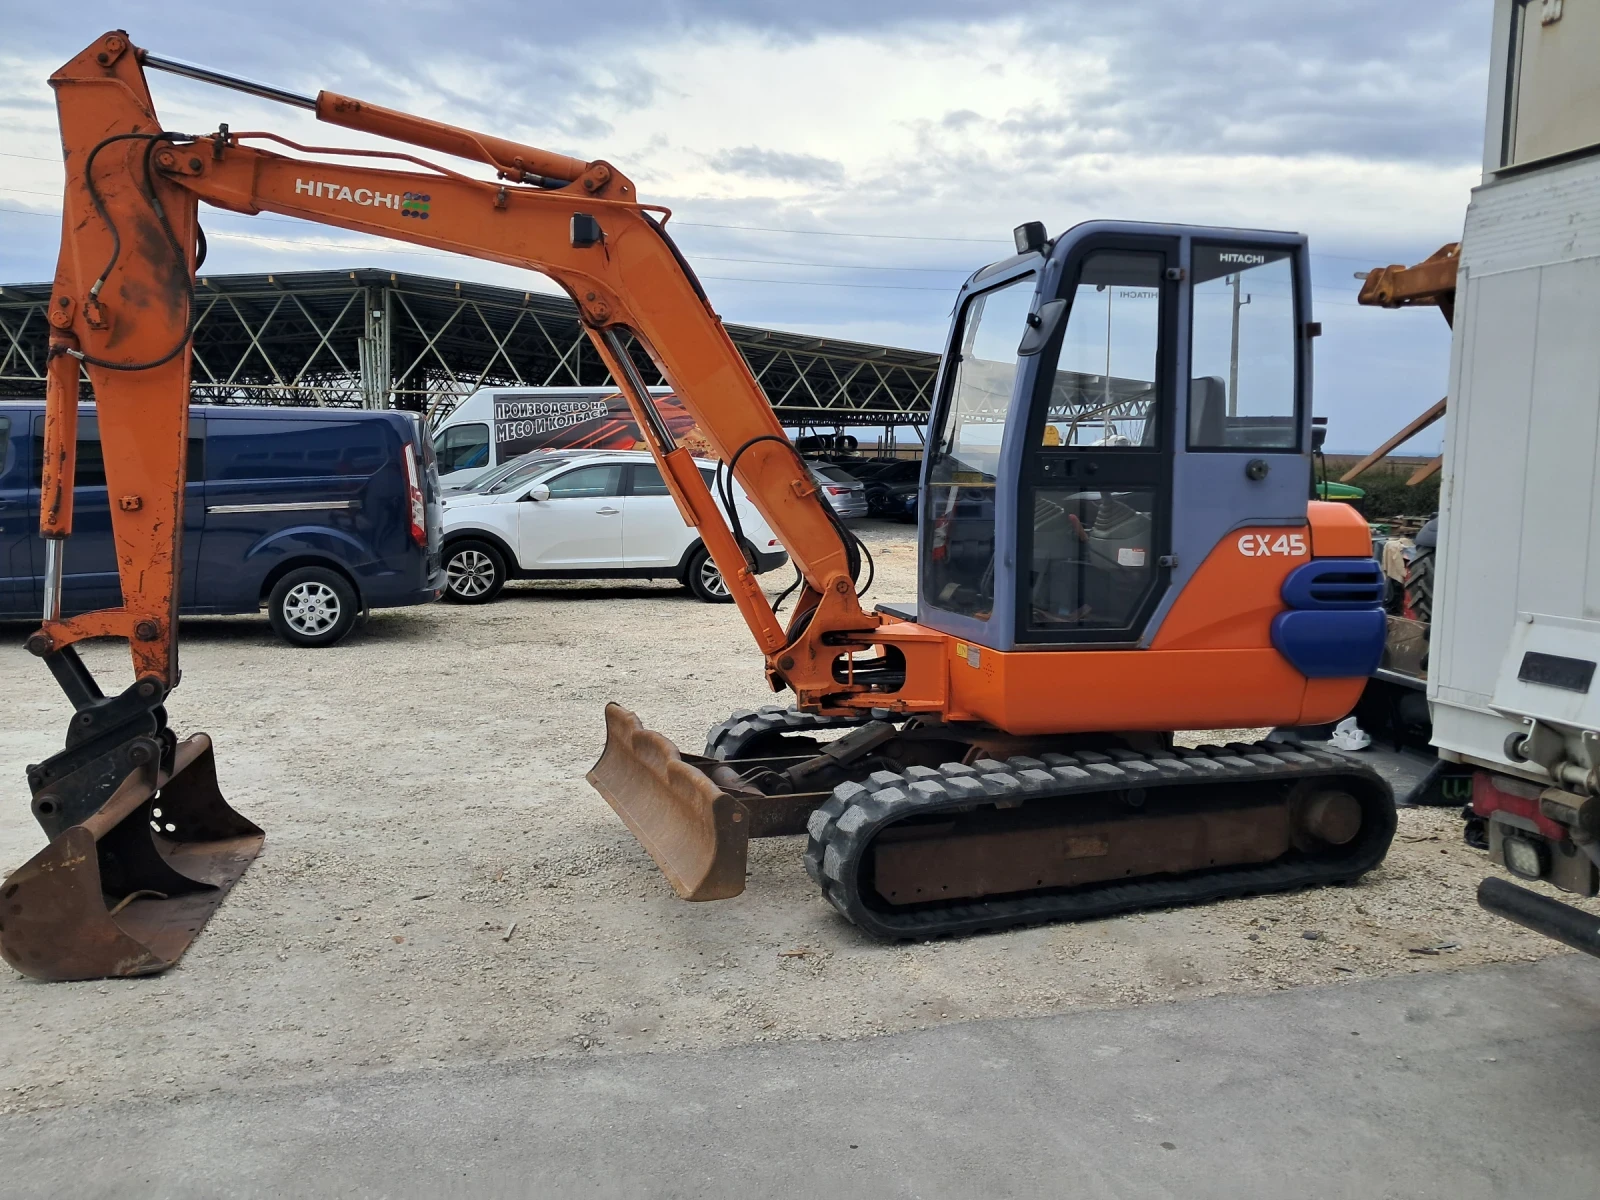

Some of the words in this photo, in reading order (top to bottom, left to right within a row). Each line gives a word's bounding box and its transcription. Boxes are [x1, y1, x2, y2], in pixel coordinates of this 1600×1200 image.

[295, 178, 400, 210] HITACHI
[1219, 253, 1265, 264] HITACHI
[494, 402, 589, 420] ПРОИЗВОДСТВО
[590, 401, 607, 410] НА
[495, 420, 533, 443] МЕСО
[535, 418, 546, 434] И
[548, 408, 609, 431] КОЛБАСИ
[1237, 533, 1307, 556] EX45
